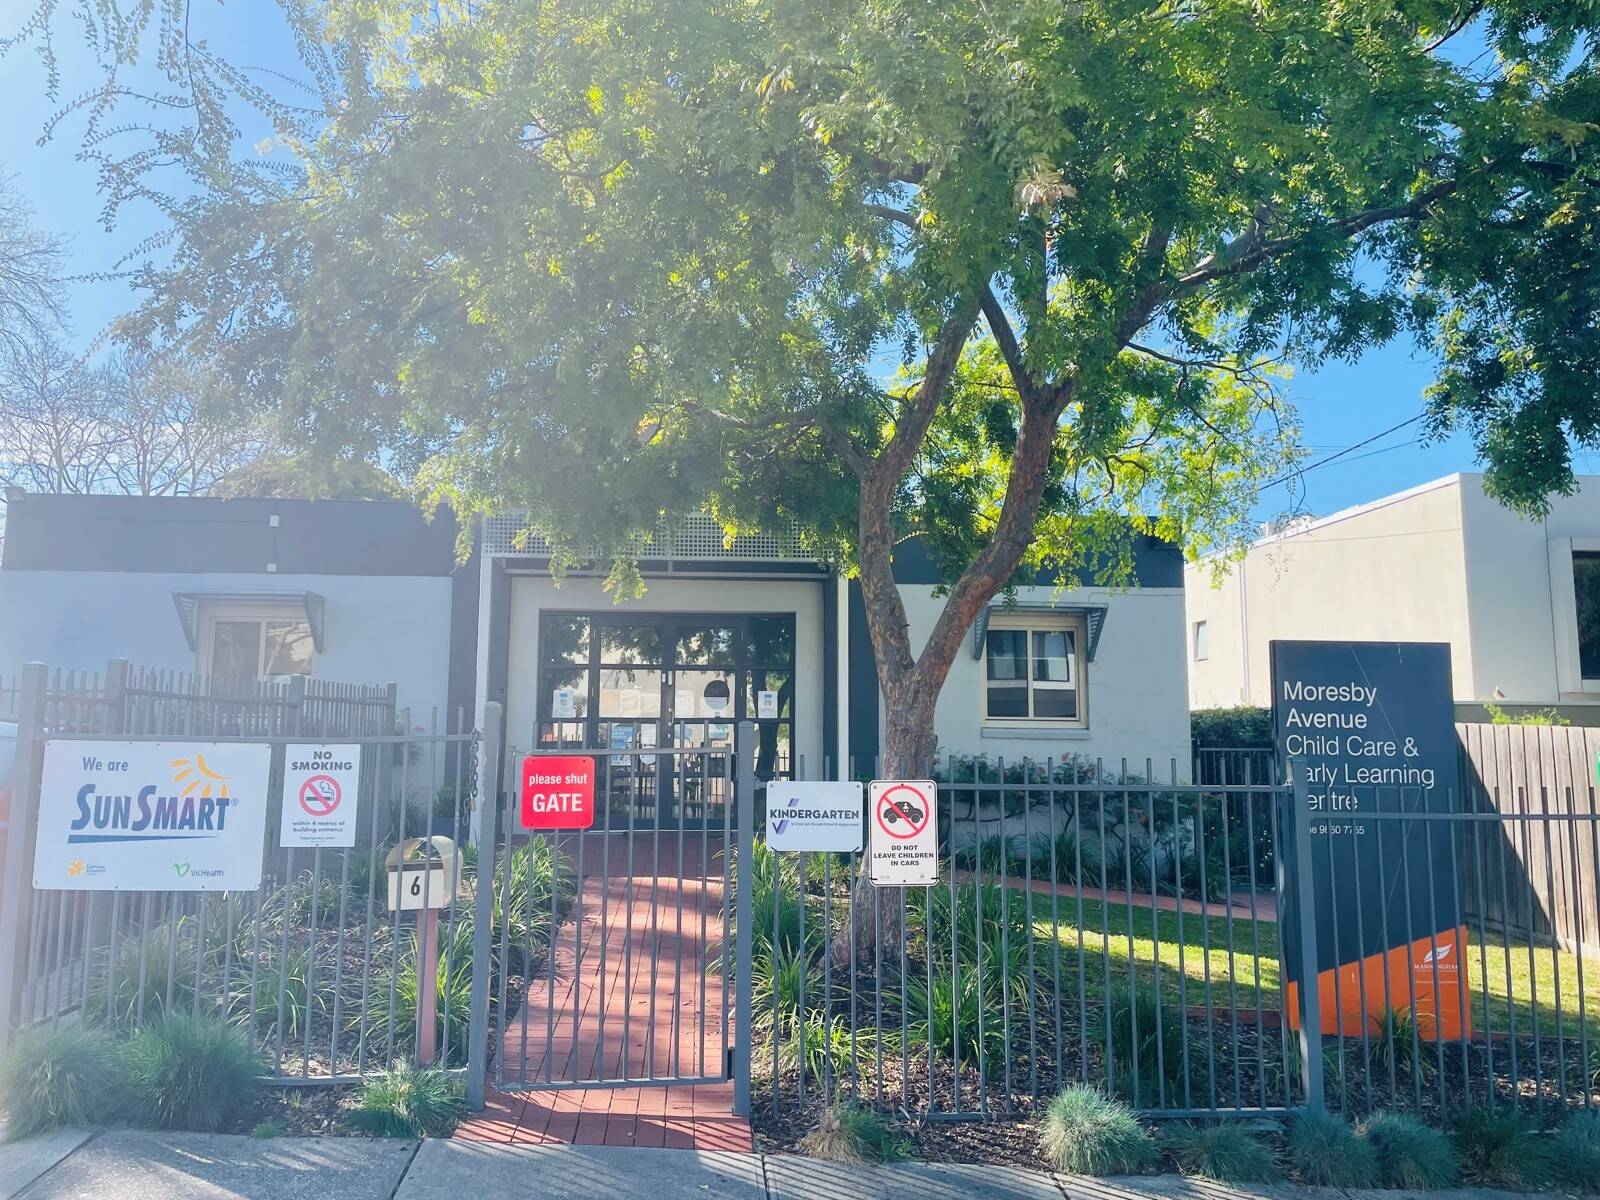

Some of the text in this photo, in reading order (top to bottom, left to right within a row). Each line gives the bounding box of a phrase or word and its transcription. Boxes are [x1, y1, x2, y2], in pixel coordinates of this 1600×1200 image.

[1284, 681, 1377, 707] Moresby
[1286, 708, 1367, 728] Avenue
[1286, 735, 1419, 756] Child Care &
[83, 757, 129, 771] We are
[313, 751, 332, 760] NO
[291, 762, 352, 771] SMOKING
[529, 773, 587, 787] please shut
[1306, 763, 1435, 789] arly Learning
[532, 793, 583, 813] GATE
[1307, 792, 1358, 810] entre
[770, 809, 859, 819] KINDERGARTEN
[191, 869, 224, 877] VicHealth
[411, 876, 420, 896] 6
